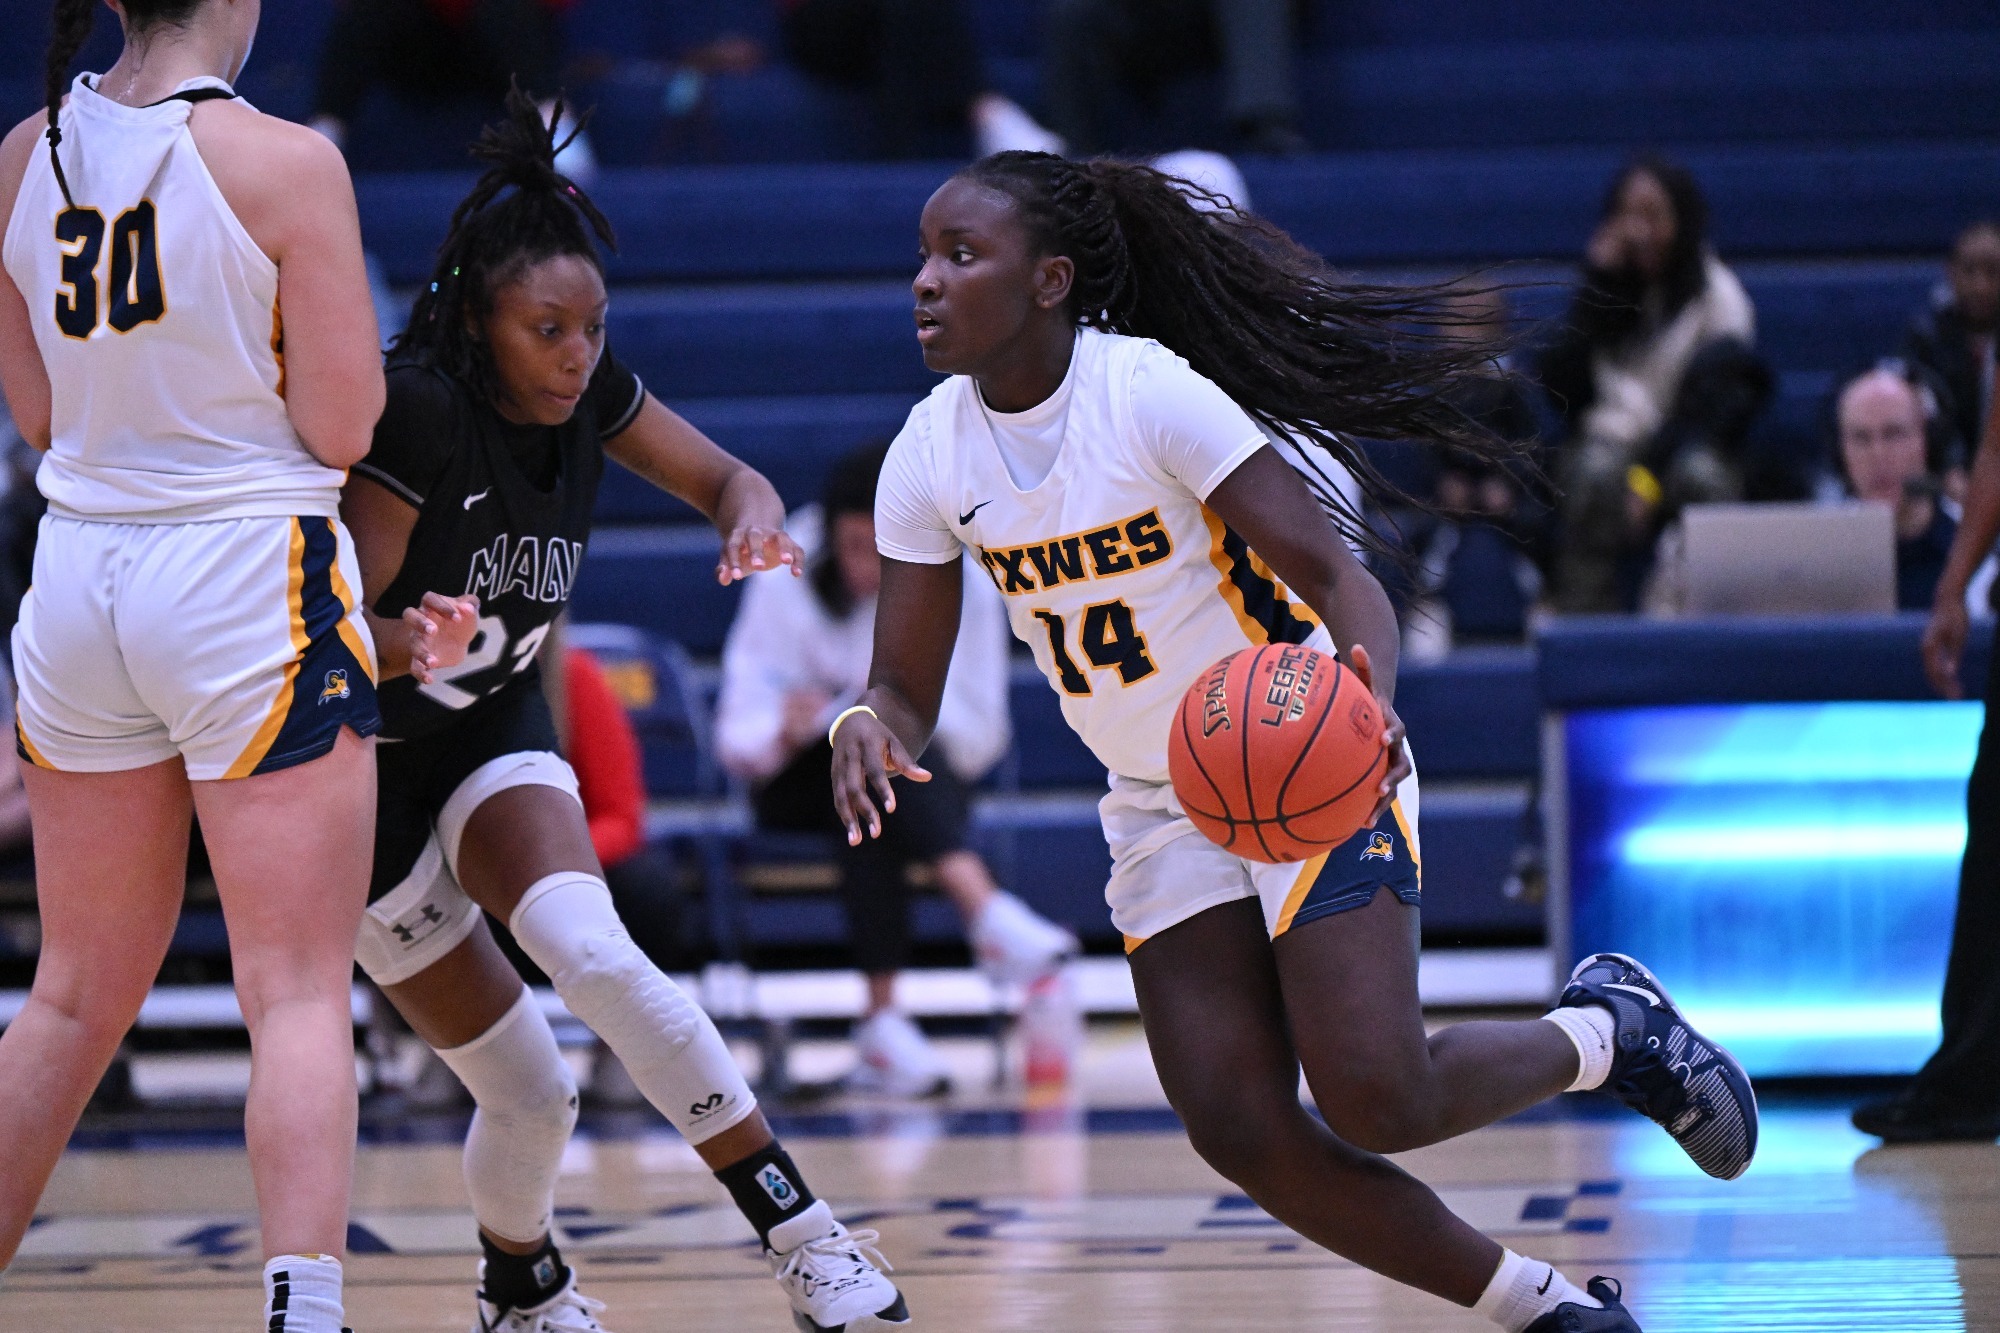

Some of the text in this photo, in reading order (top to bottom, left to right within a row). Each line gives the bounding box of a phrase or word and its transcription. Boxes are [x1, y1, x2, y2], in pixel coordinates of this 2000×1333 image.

[54, 197, 167, 341] 30
[1031, 597, 1160, 697] 14
[1260, 644, 1304, 728] LEGAC
